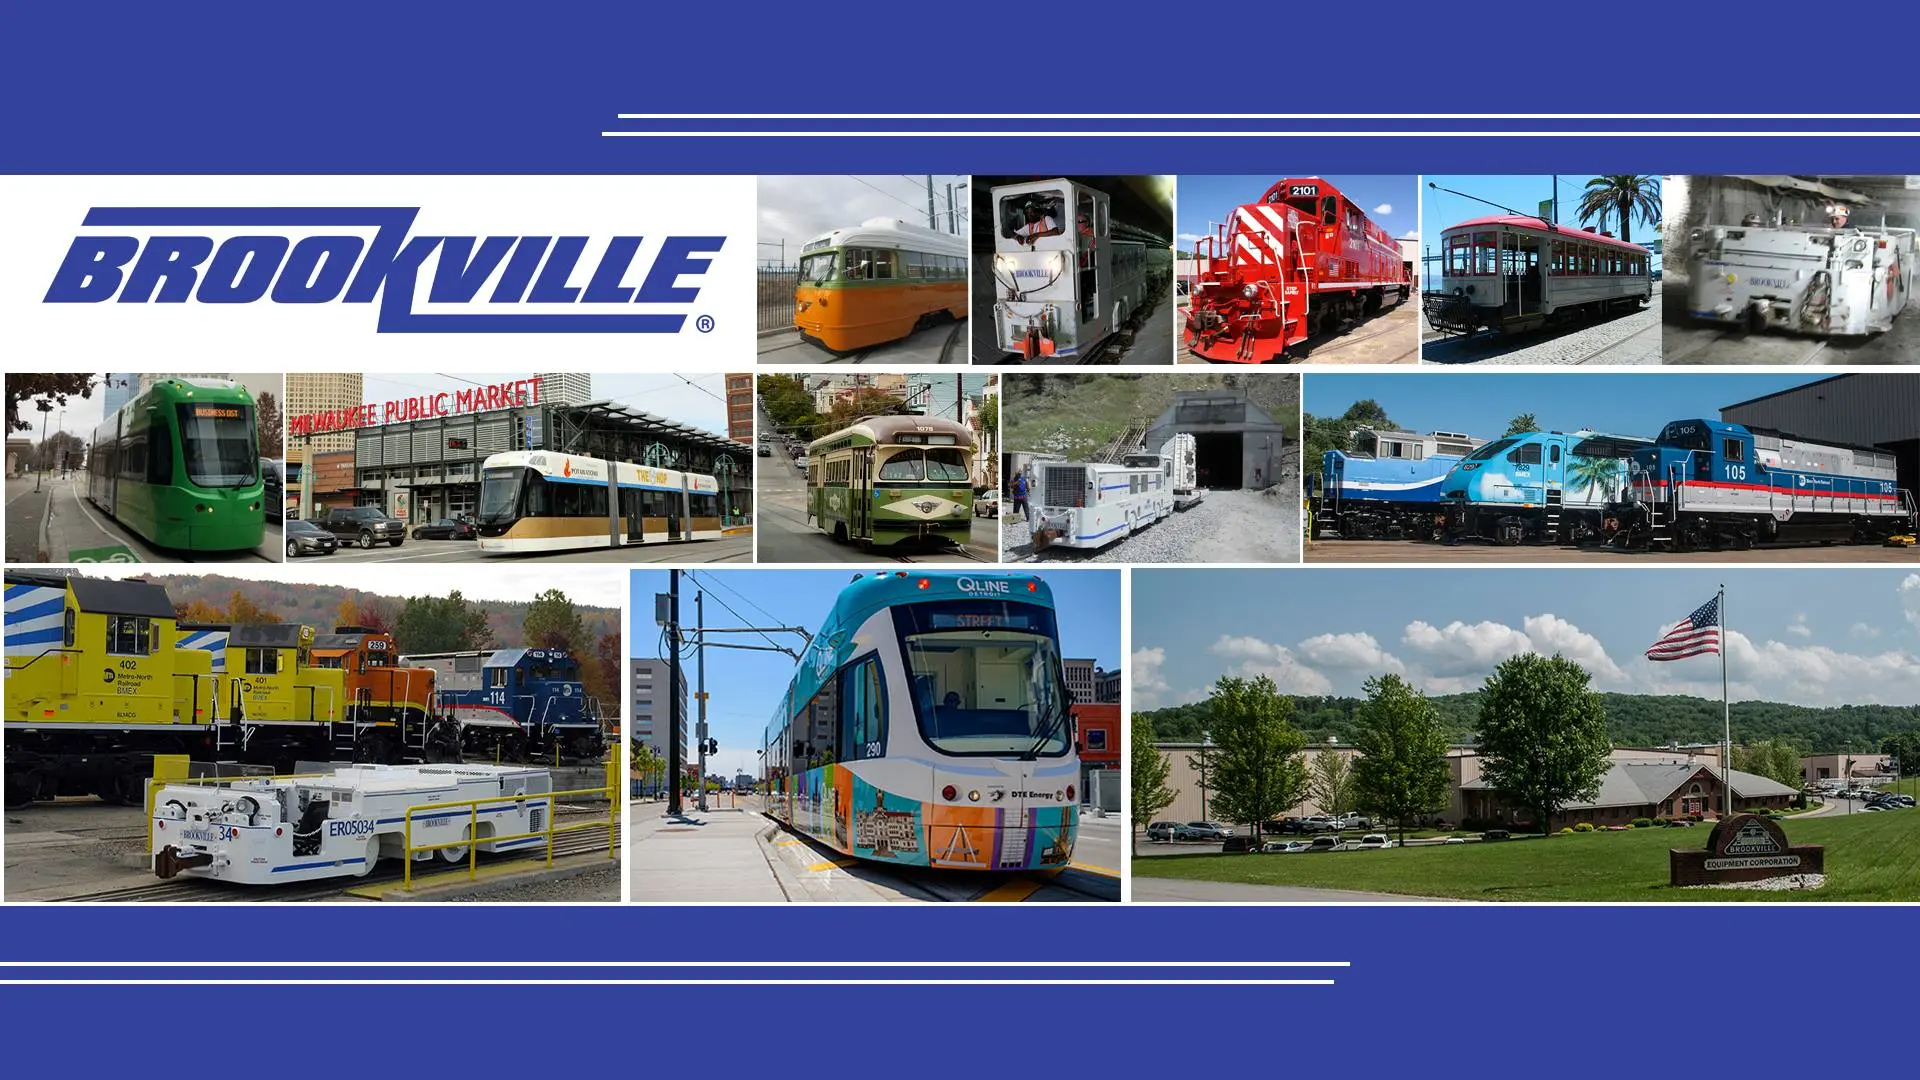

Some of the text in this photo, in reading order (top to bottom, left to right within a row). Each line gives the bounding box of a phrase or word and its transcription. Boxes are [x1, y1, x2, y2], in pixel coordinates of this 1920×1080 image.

[1293, 186, 1316, 195] 2101
[289, 378, 543, 435] MILWAUKEE PUBLIC MARKET
[1680, 425, 1696, 434] 105
[636, 469, 649, 482] THE
[1724, 464, 1746, 480] 105
[1880, 481, 1893, 493] 105
[957, 577, 1010, 593] QLINE
[370, 641, 385, 650] 259
[119, 660, 137, 670] 402
[117, 673, 153, 681] Metro-North
[255, 676, 267, 684] 401
[117, 686, 138, 695] BMEX
[490, 691, 505, 705] 114
[866, 741, 881, 758] 290
[1011, 791, 1053, 800] DTE Energy
[329, 819, 375, 837] ER05034
[183, 830, 214, 841] BROOKVILLE
[218, 826, 232, 842] 34
[1729, 844, 1776, 853] BROOKVILLE
[1706, 857, 1799, 869] EQUIPMENT CORPORATION
